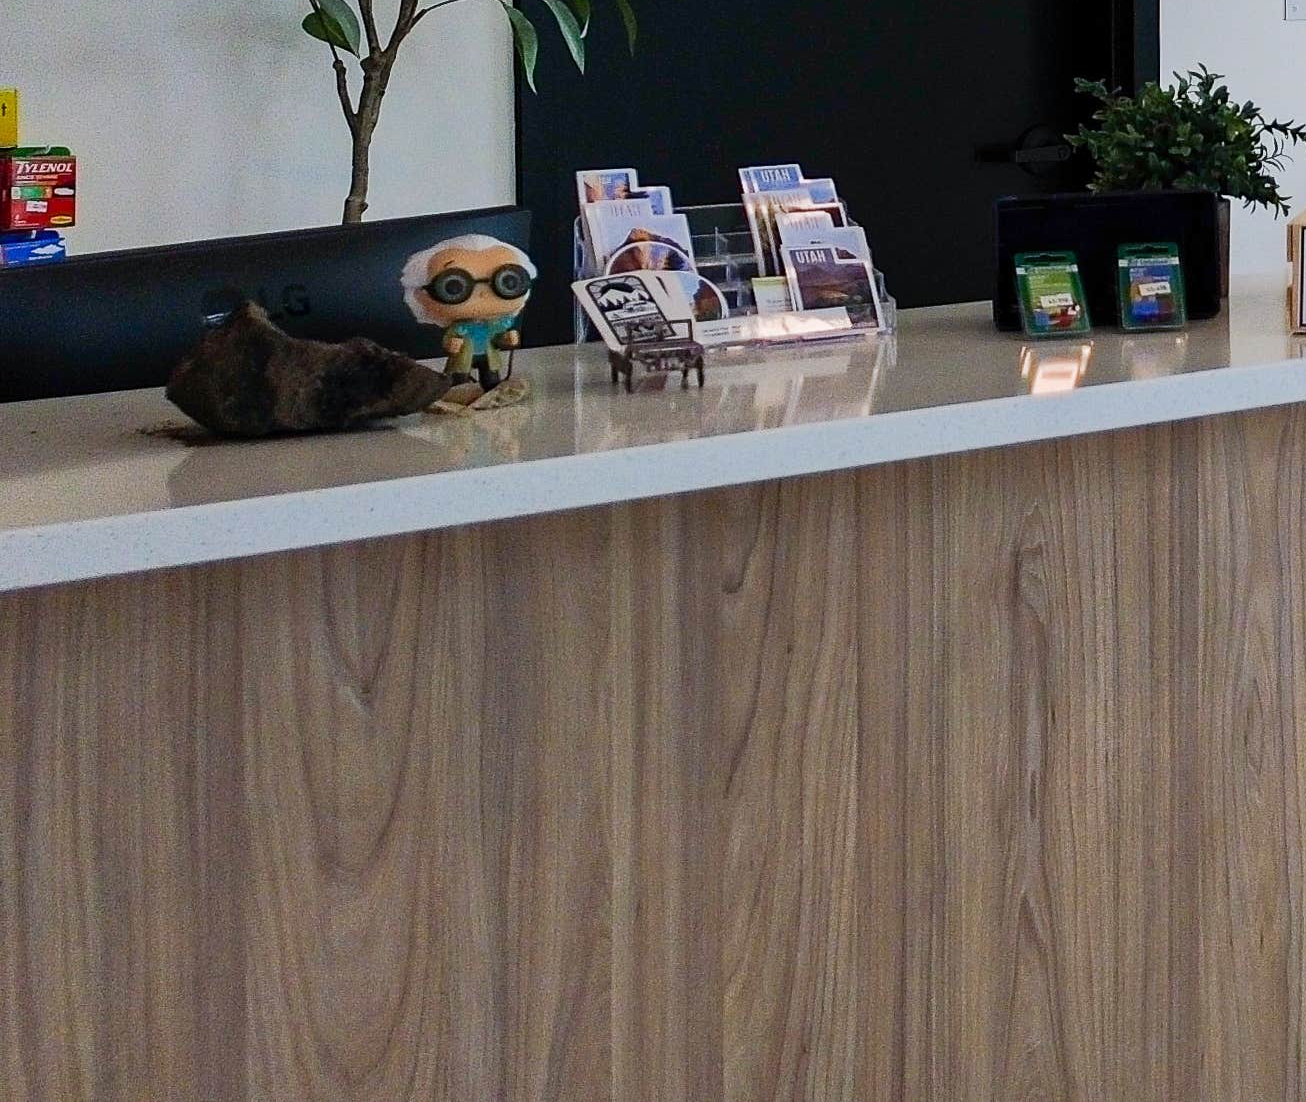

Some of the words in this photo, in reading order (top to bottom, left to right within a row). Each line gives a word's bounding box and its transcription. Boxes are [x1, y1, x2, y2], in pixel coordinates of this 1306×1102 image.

[16, 161, 73, 174] TYLENOL
[760, 168, 790, 182] UTAH
[795, 250, 827, 263] UTAH
